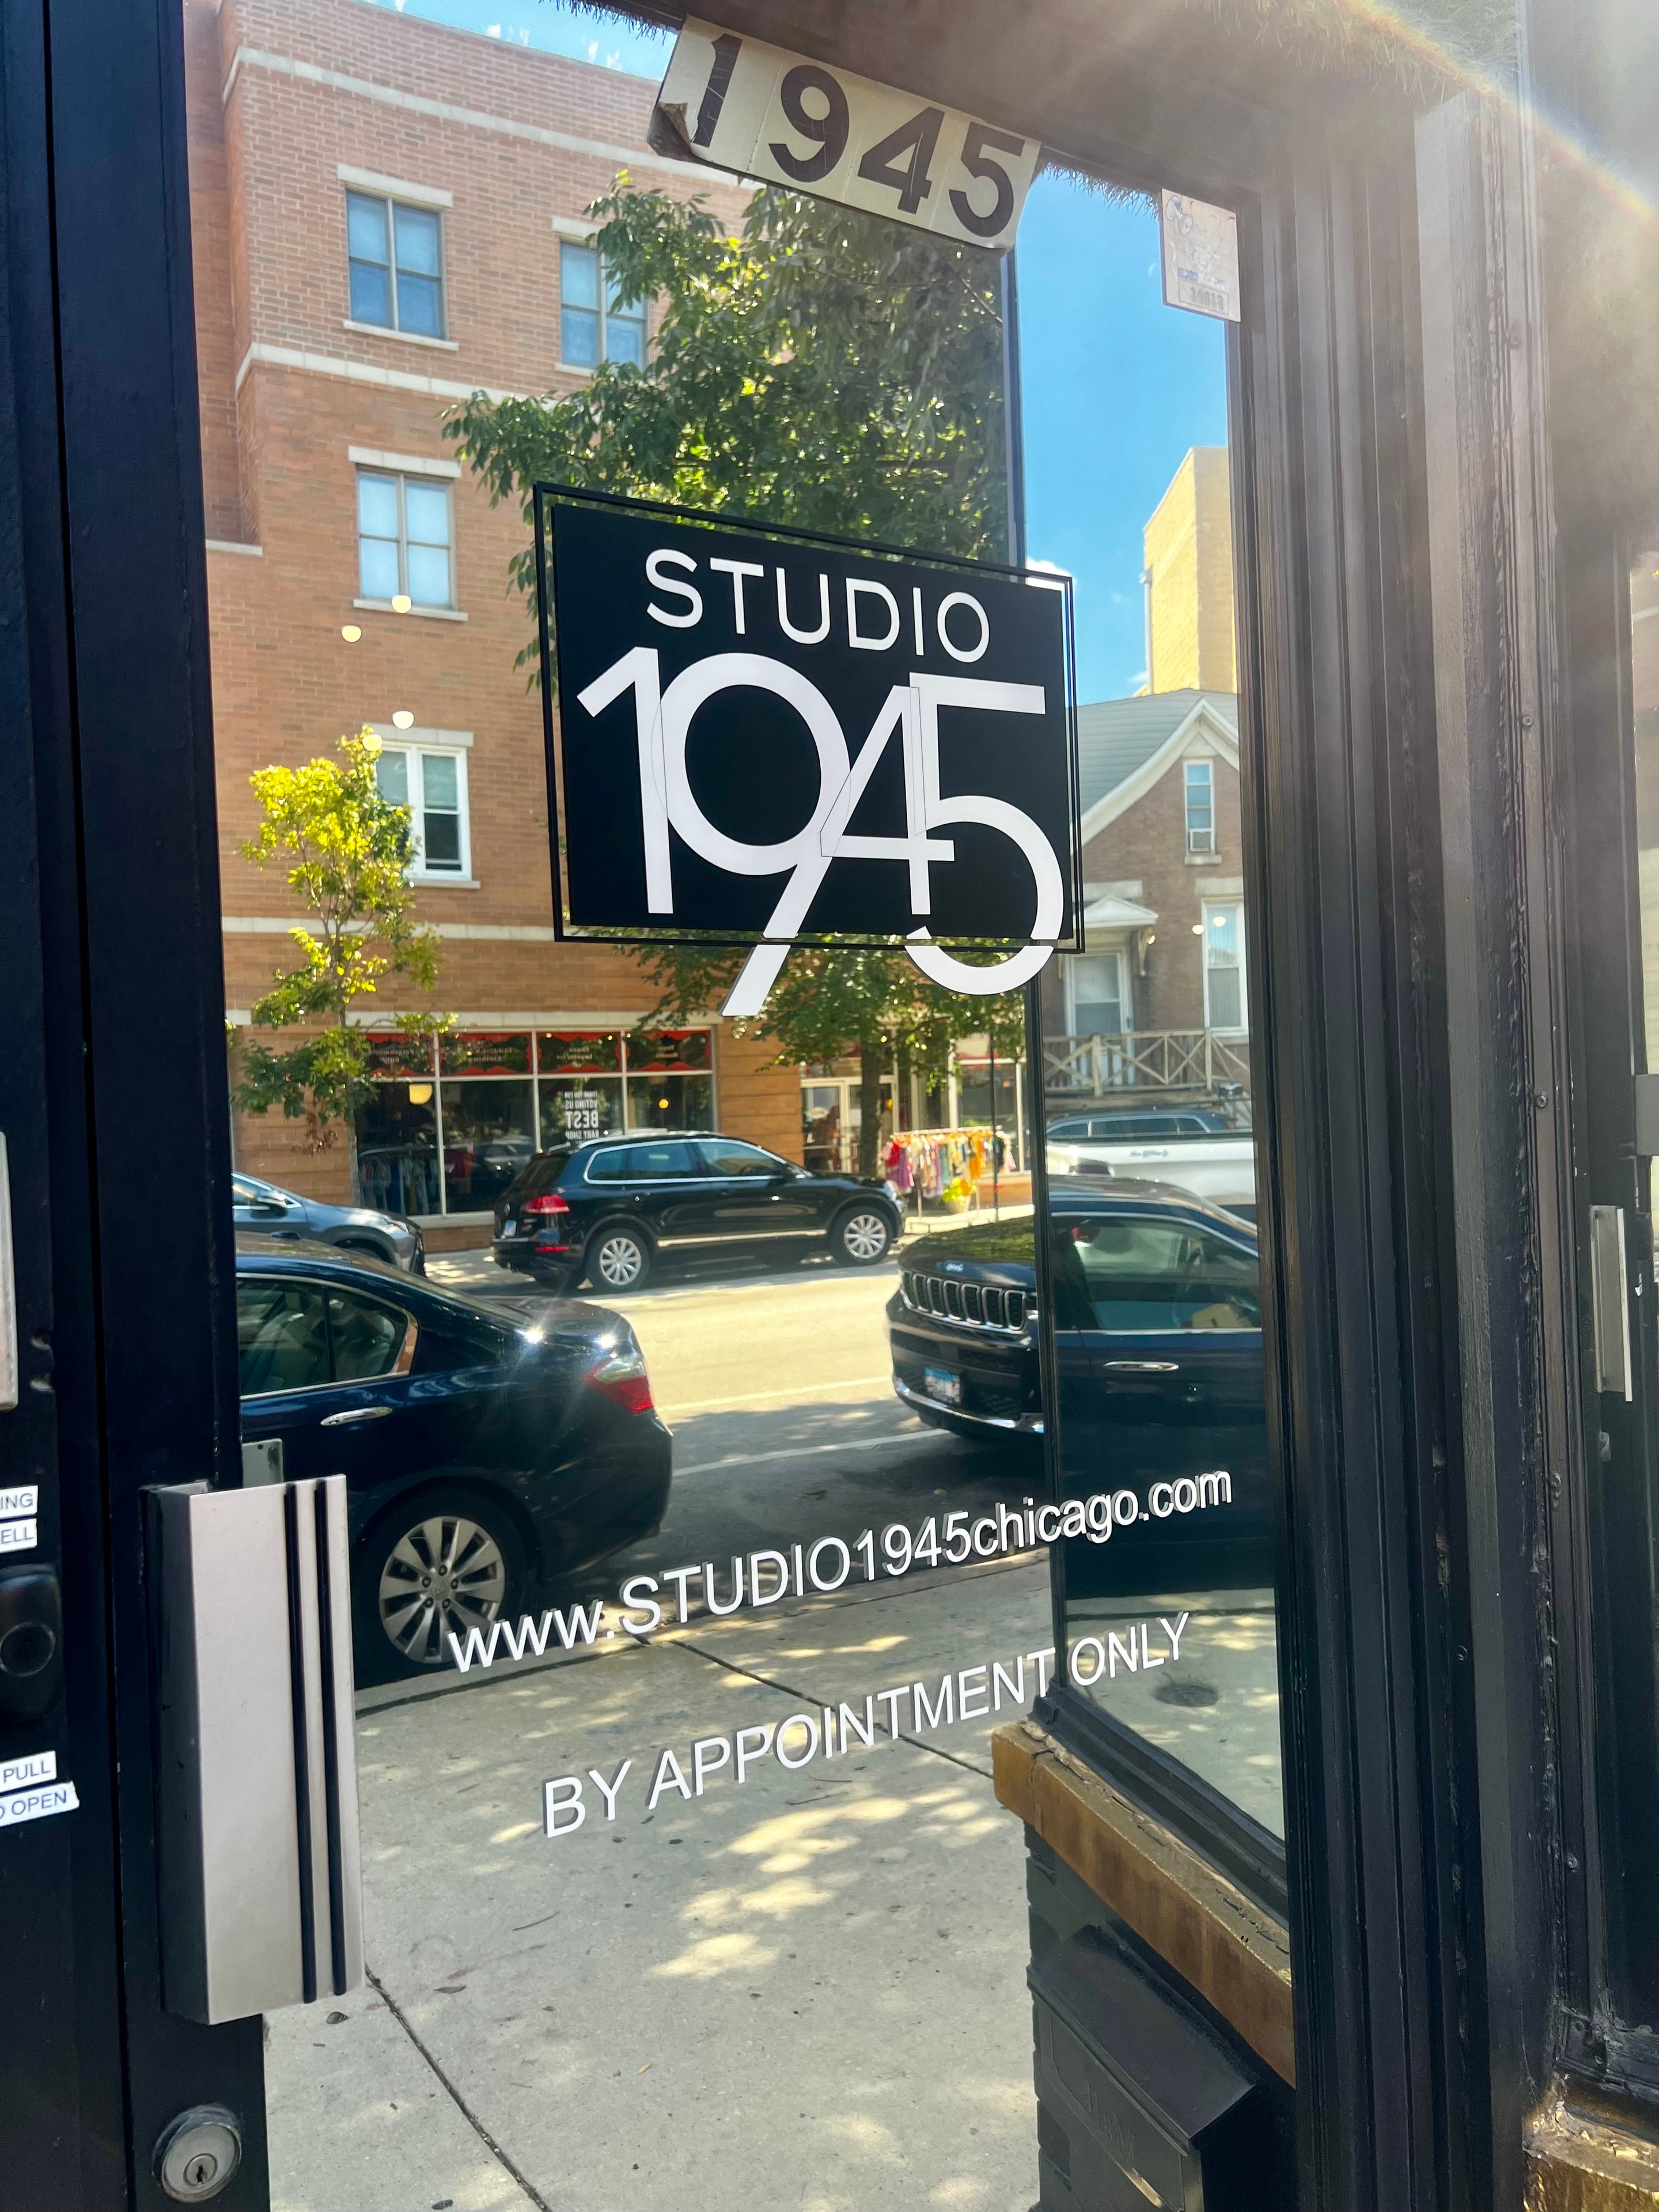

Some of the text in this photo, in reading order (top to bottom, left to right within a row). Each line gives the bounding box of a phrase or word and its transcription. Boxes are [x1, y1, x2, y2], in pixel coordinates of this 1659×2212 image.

[692, 33, 1025, 237] 1945
[645, 549, 990, 663] STUDIO
[577, 646, 1065, 1017] 1945
[0, 1493, 33, 1510] ING
[0, 1527, 34, 1544] ELL
[448, 1471, 1232, 1673] www.STUDIO1945chicago.com
[3, 1760, 51, 1783] PULL
[544, 1612, 1190, 1839] BY APPOINTMENT ONLY
[12, 1789, 67, 1815] OPEN
